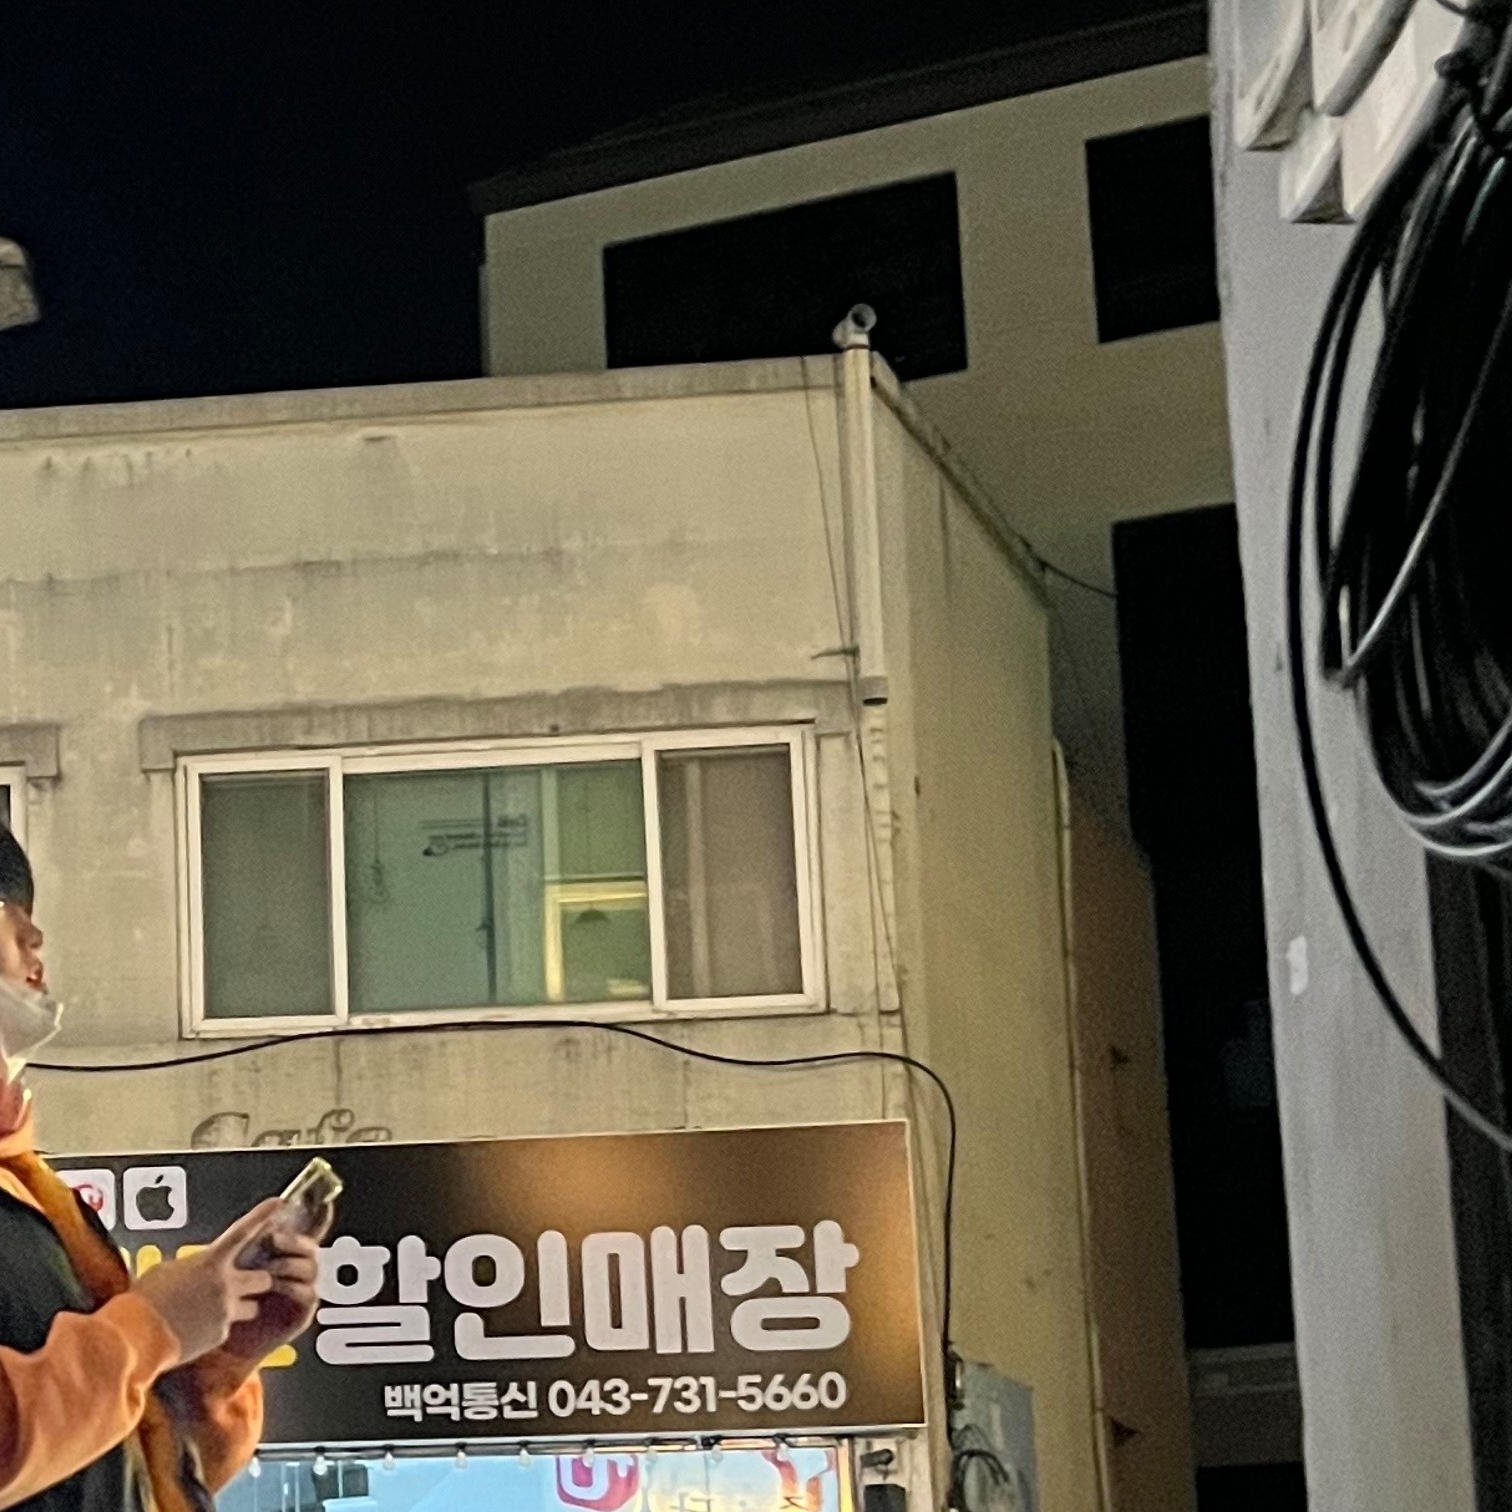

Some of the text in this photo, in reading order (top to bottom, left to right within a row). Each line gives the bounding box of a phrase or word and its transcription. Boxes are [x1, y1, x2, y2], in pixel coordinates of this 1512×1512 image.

[316, 1220, 860, 1366] 할인매장
[384, 1371, 847, 1422] 백억통신 043-731-5660
